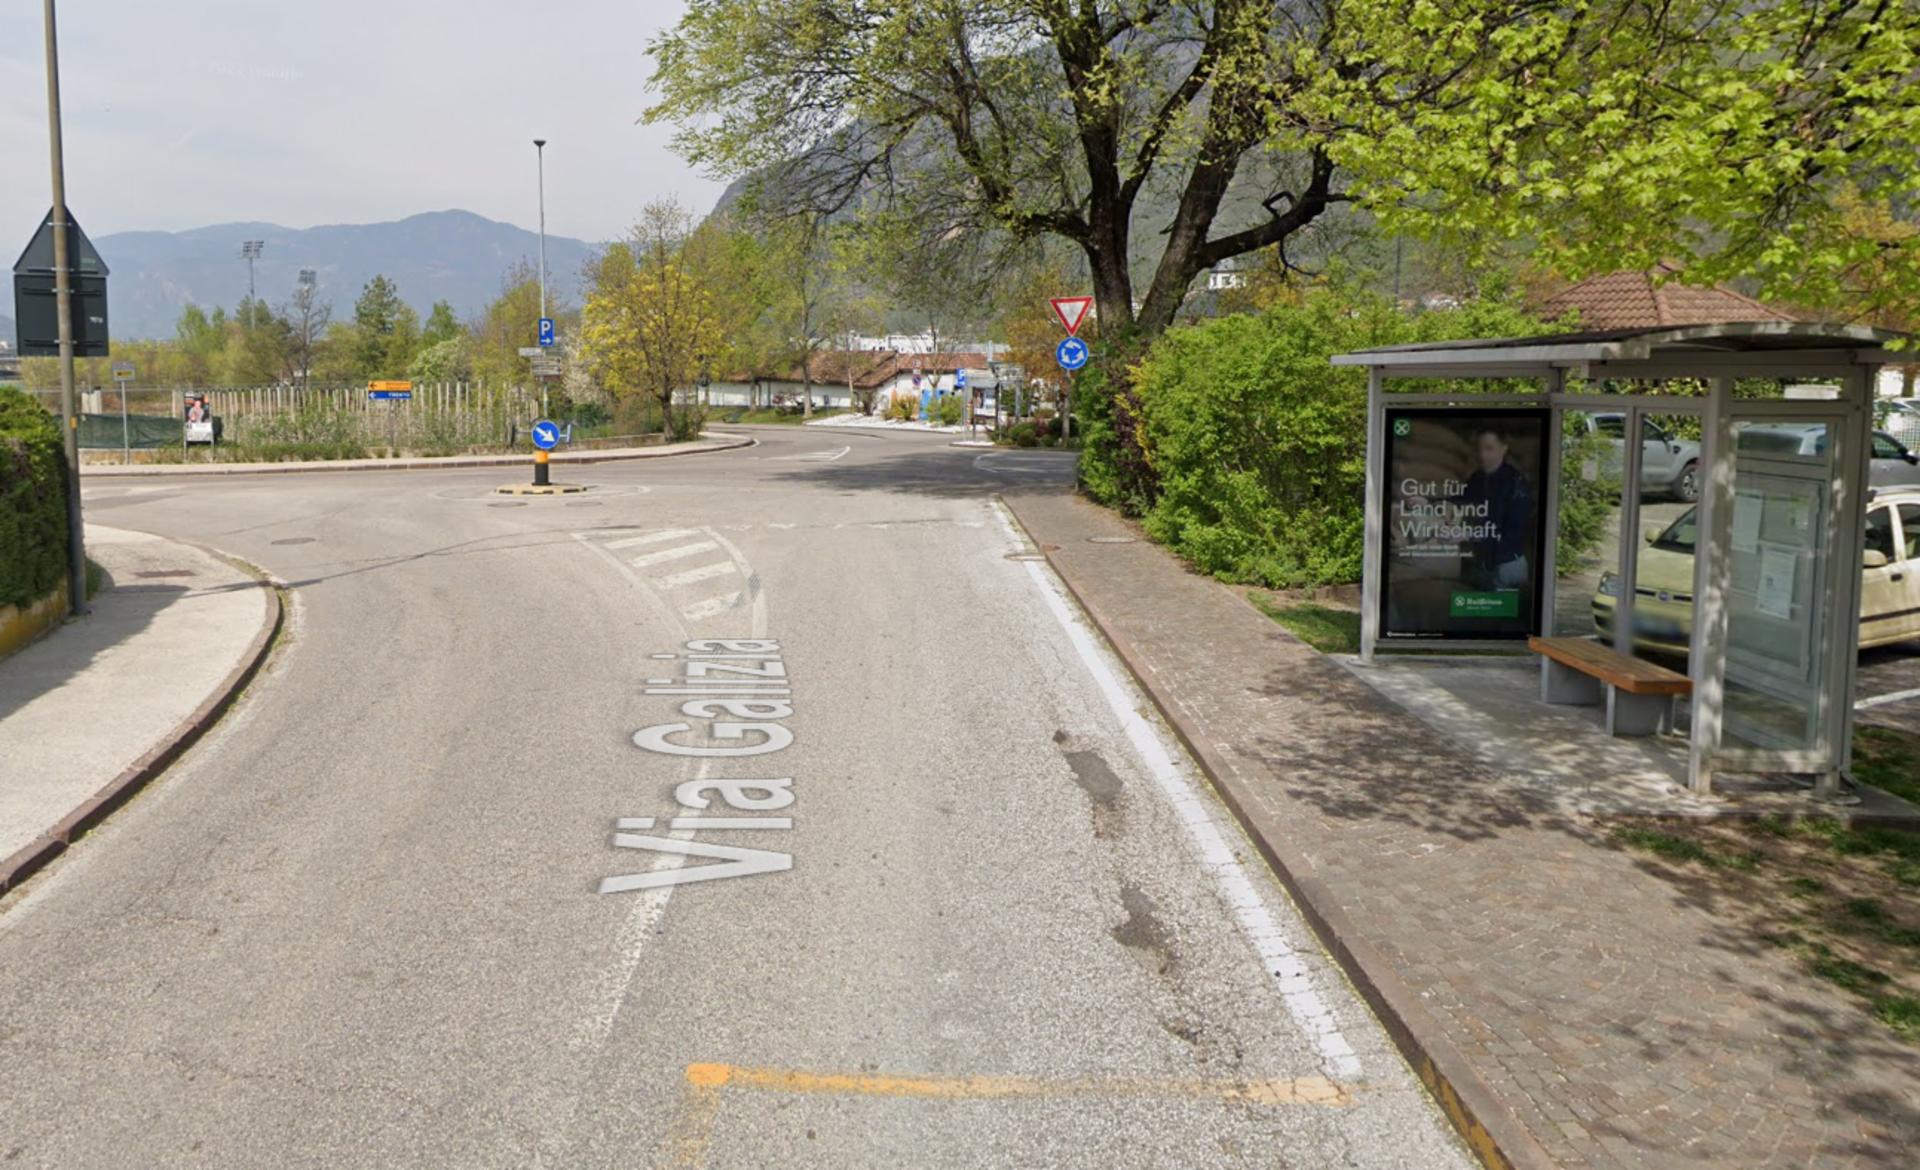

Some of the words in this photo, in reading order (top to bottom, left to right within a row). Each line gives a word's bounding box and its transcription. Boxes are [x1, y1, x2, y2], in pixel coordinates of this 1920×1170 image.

[541, 320, 551, 336] P
[1401, 478, 1437, 496] Gut
[1443, 479, 1468, 496] für
[1400, 500, 1447, 517] Land
[1453, 499, 1489, 517] und
[1400, 520, 1502, 541] Wirtschaft,
